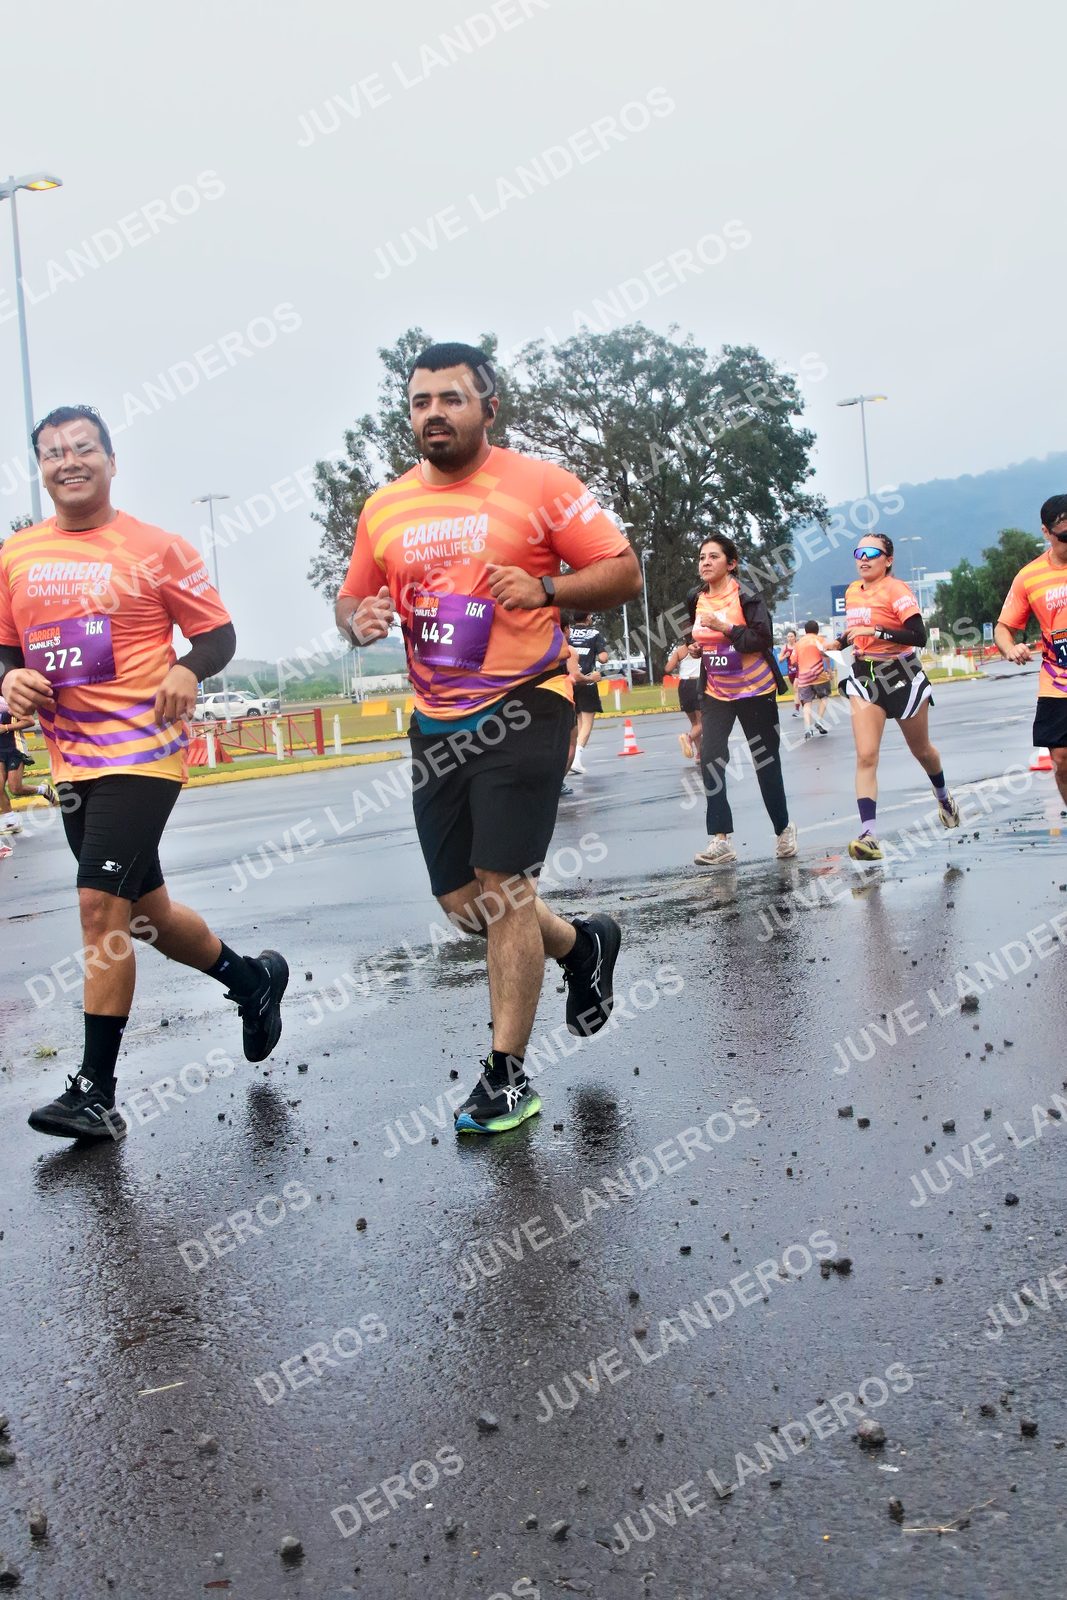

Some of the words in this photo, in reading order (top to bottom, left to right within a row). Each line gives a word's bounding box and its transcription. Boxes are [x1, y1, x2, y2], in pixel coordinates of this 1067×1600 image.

[402, 513, 489, 548] CARRERA
[404, 541, 468, 564] OMNILIFE
[28, 562, 112, 581] CARRERA
[27, 583, 88, 597] OMNILIFE
[29, 627, 60, 642] CARRERA
[421, 622, 455, 645] 442
[29, 641, 54, 651] OMNILIFE
[44, 647, 83, 672] 272
[709, 656, 728, 667] 720
